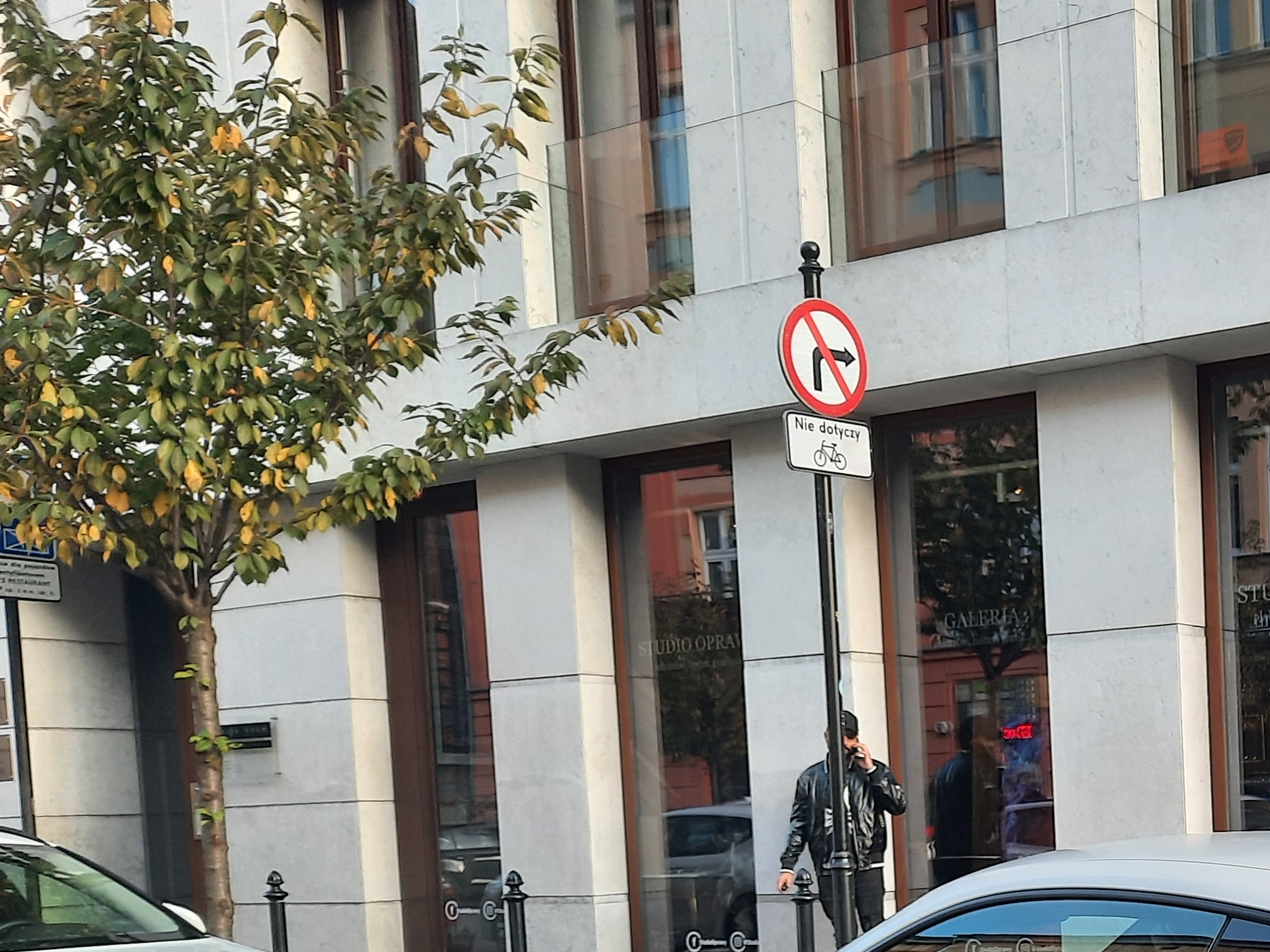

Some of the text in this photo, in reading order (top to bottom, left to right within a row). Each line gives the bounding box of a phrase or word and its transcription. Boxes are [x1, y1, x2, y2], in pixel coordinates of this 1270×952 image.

[795, 416, 861, 443] Nie dotyczy
[945, 608, 1019, 630] GALERIA
